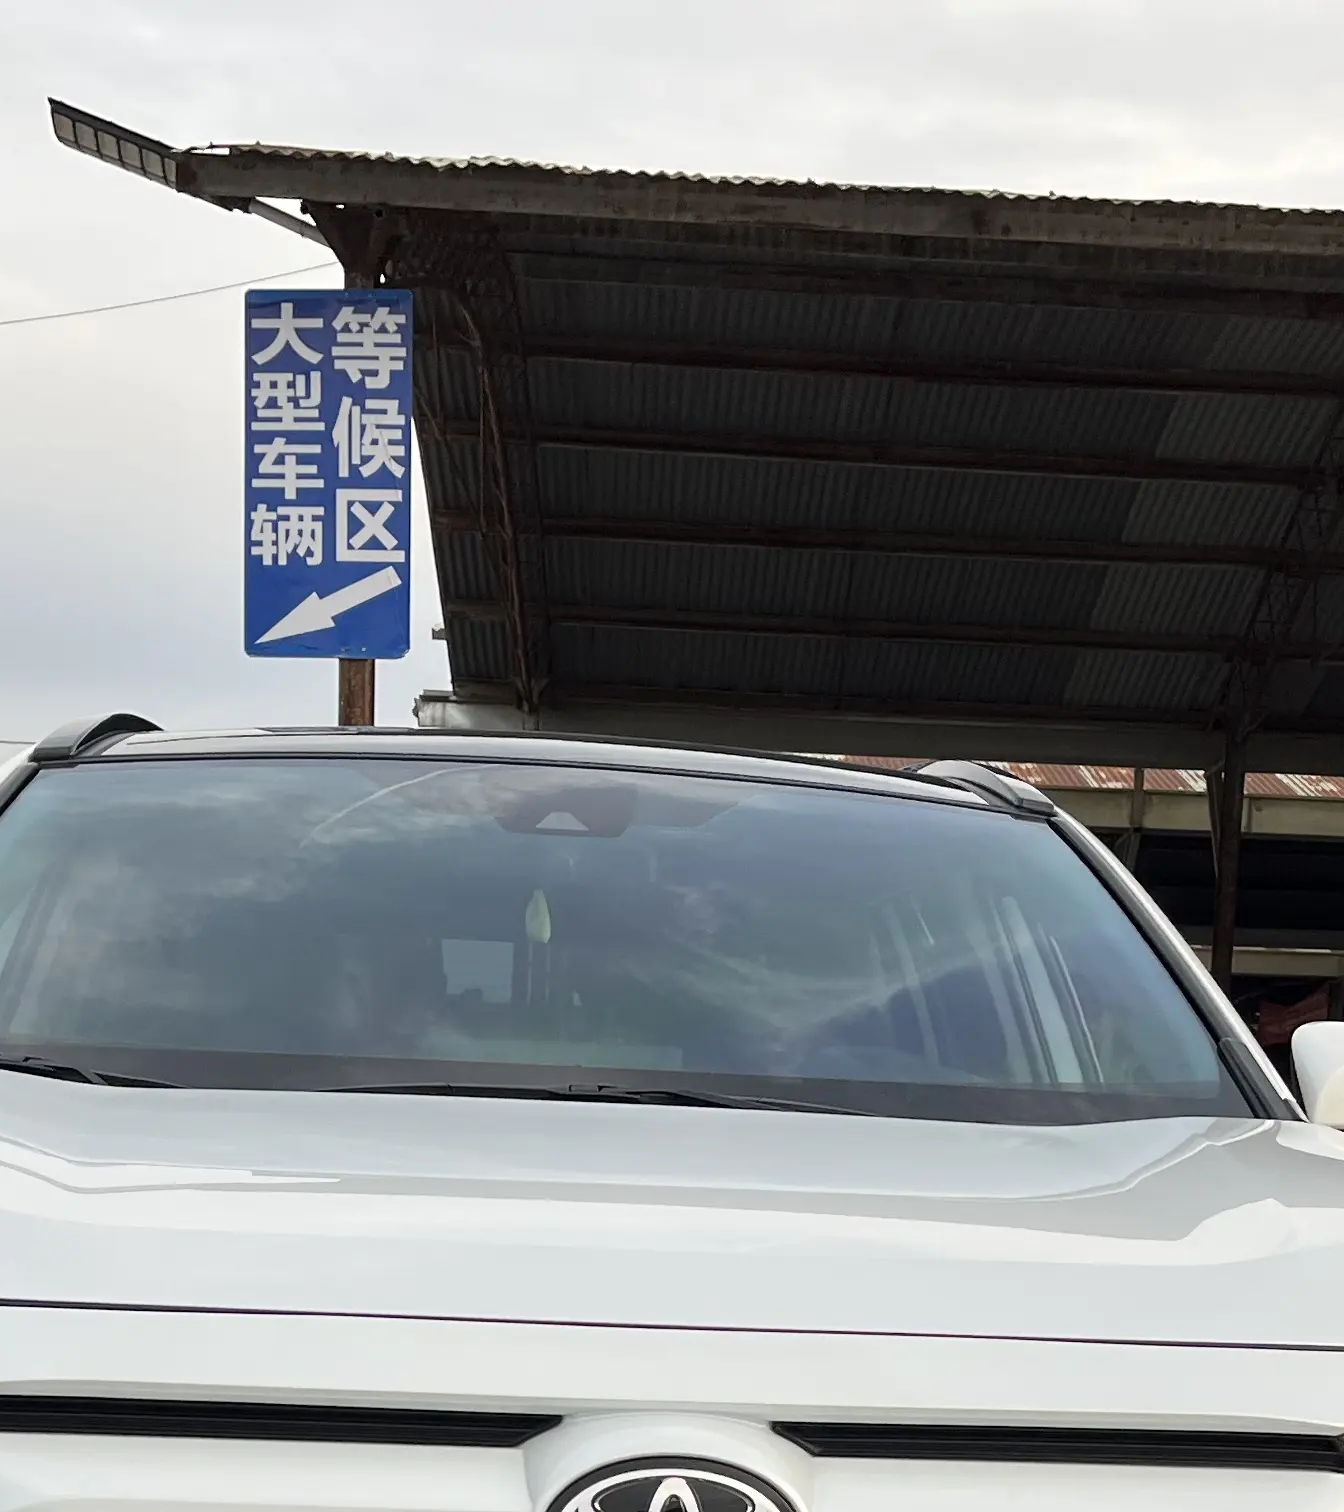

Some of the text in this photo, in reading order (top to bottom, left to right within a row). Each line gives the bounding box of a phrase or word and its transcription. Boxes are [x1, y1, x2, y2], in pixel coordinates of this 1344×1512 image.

[250, 301, 326, 566] 大型车辆
[331, 305, 408, 563] 等候区
